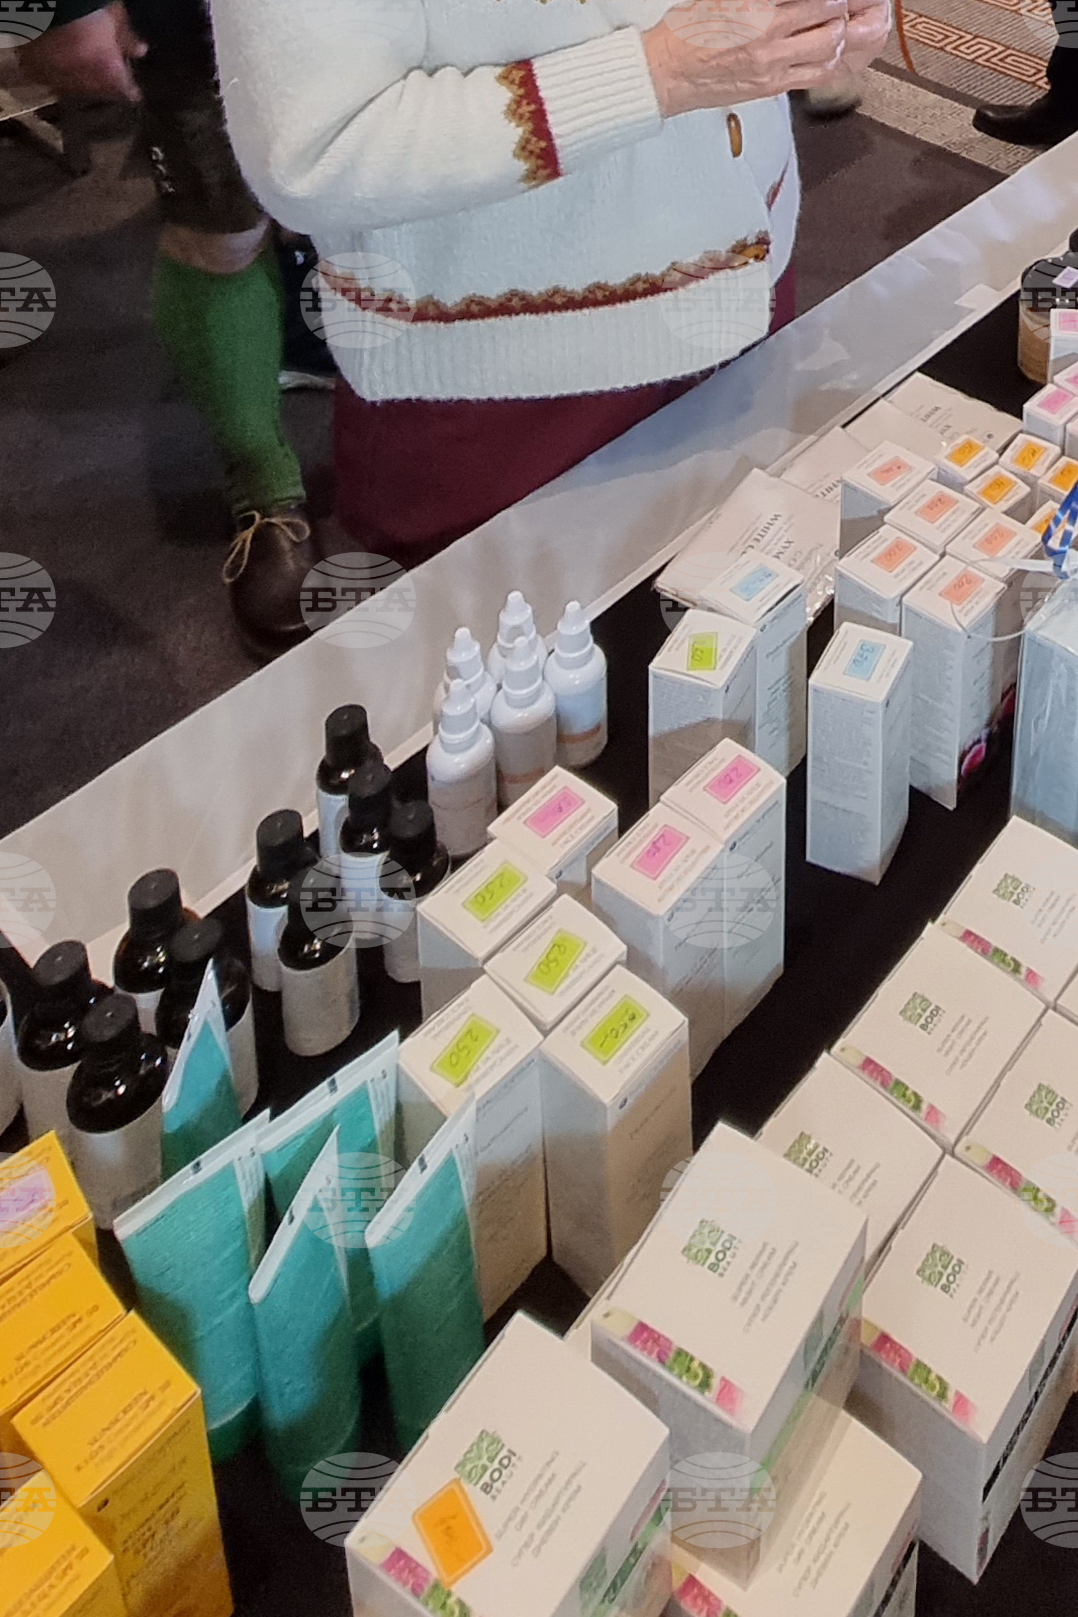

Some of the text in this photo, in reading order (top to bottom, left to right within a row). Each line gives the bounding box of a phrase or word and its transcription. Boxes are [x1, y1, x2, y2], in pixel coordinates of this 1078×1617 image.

[474, 871, 506, 905] 250
[1011, 881, 1031, 906] BODI
[537, 943, 568, 976] 250
[918, 1002, 942, 1032] BODI
[448, 1030, 479, 1068] 250
[1044, 1096, 1069, 1127] BODI
[804, 1144, 830, 1176] ODI
[705, 1232, 738, 1274] BODI
[716, 1238, 745, 1279] BEAUTY
[937, 1257, 967, 1294] BODI
[478, 1446, 518, 1497] BODI
[490, 1454, 524, 1502] BEAUTY
